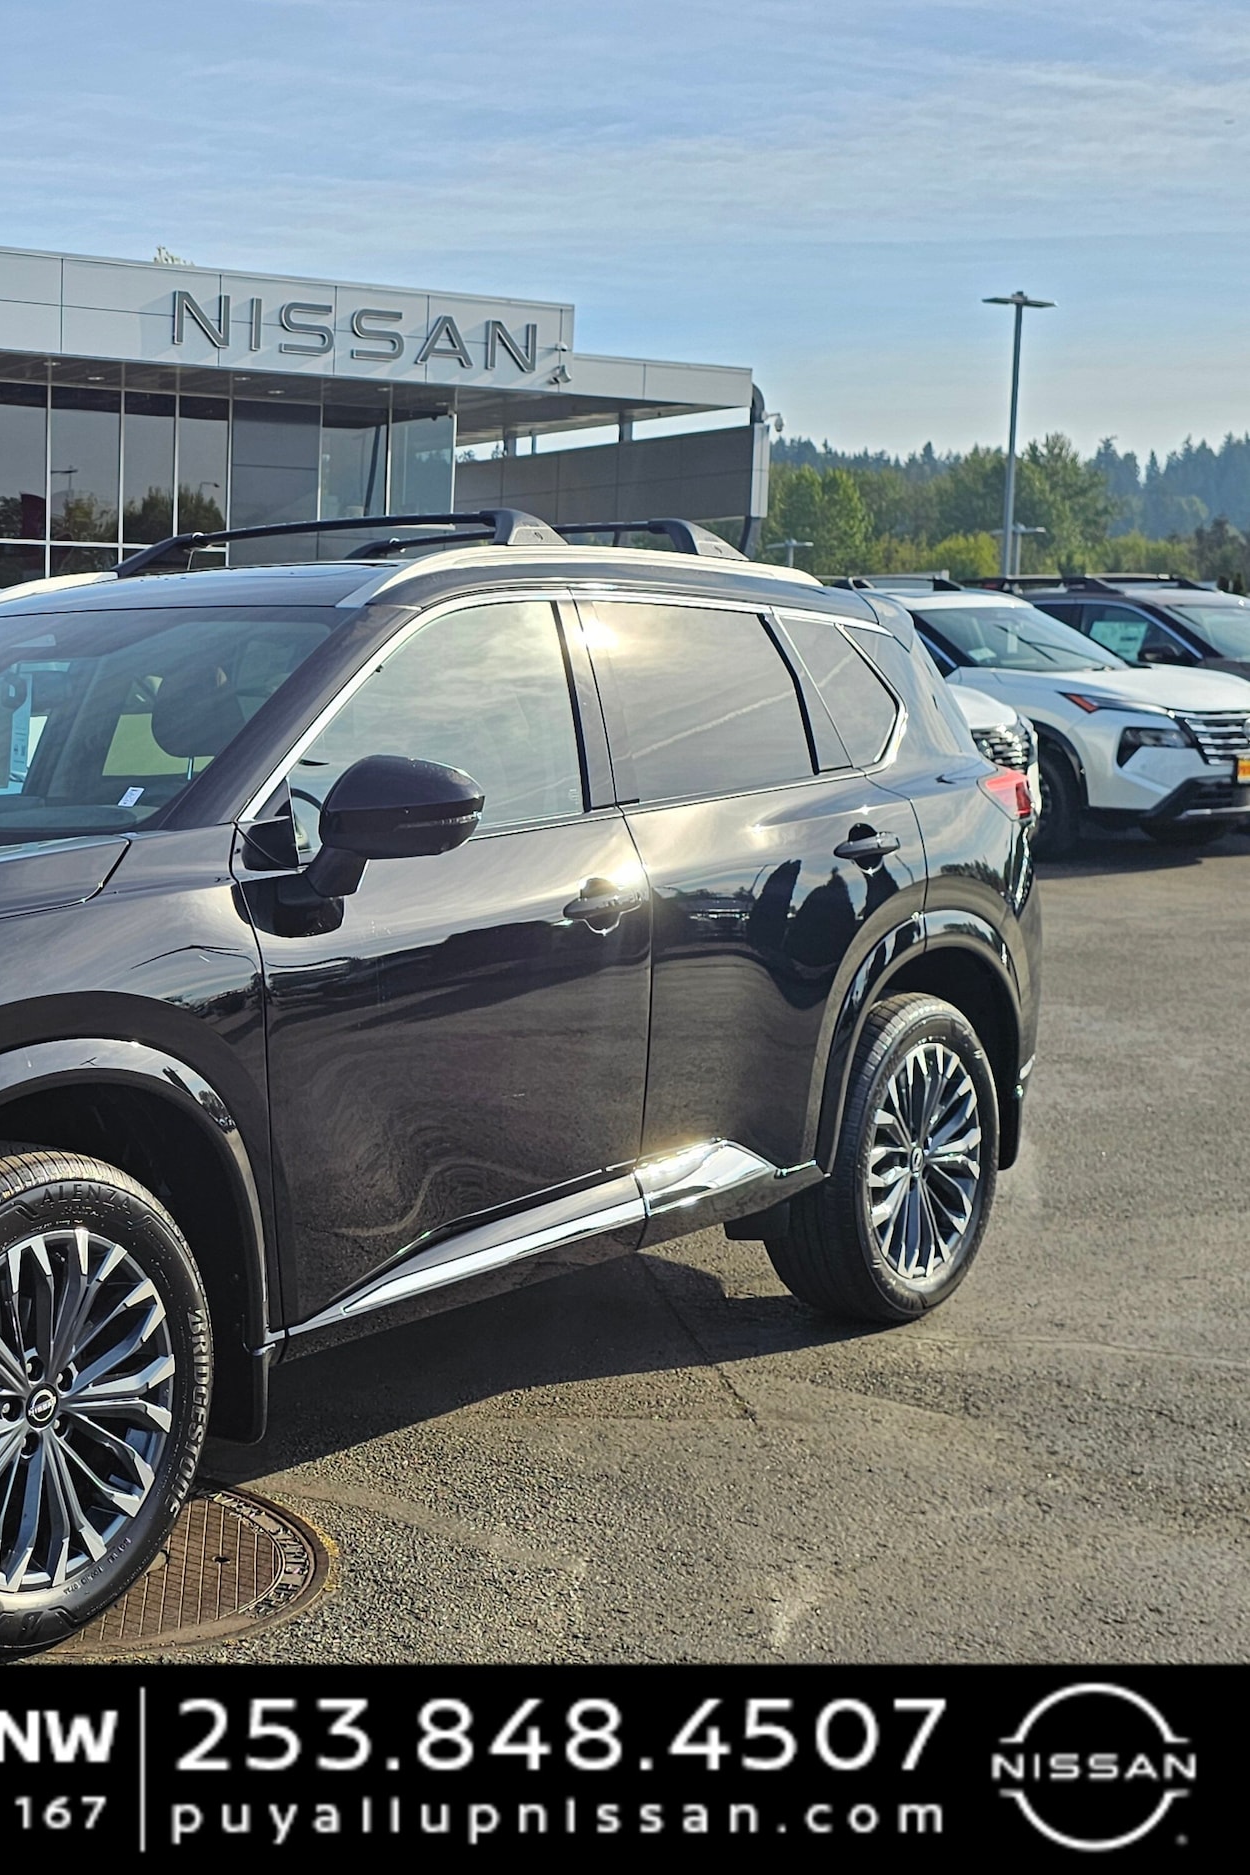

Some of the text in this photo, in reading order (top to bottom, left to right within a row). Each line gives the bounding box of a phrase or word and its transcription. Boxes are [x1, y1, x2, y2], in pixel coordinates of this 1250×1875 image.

[171, 290, 538, 373] NISSAN
[41, 1183, 133, 1215] ALENZA
[163, 1308, 209, 1519] BRIDGESTONE
